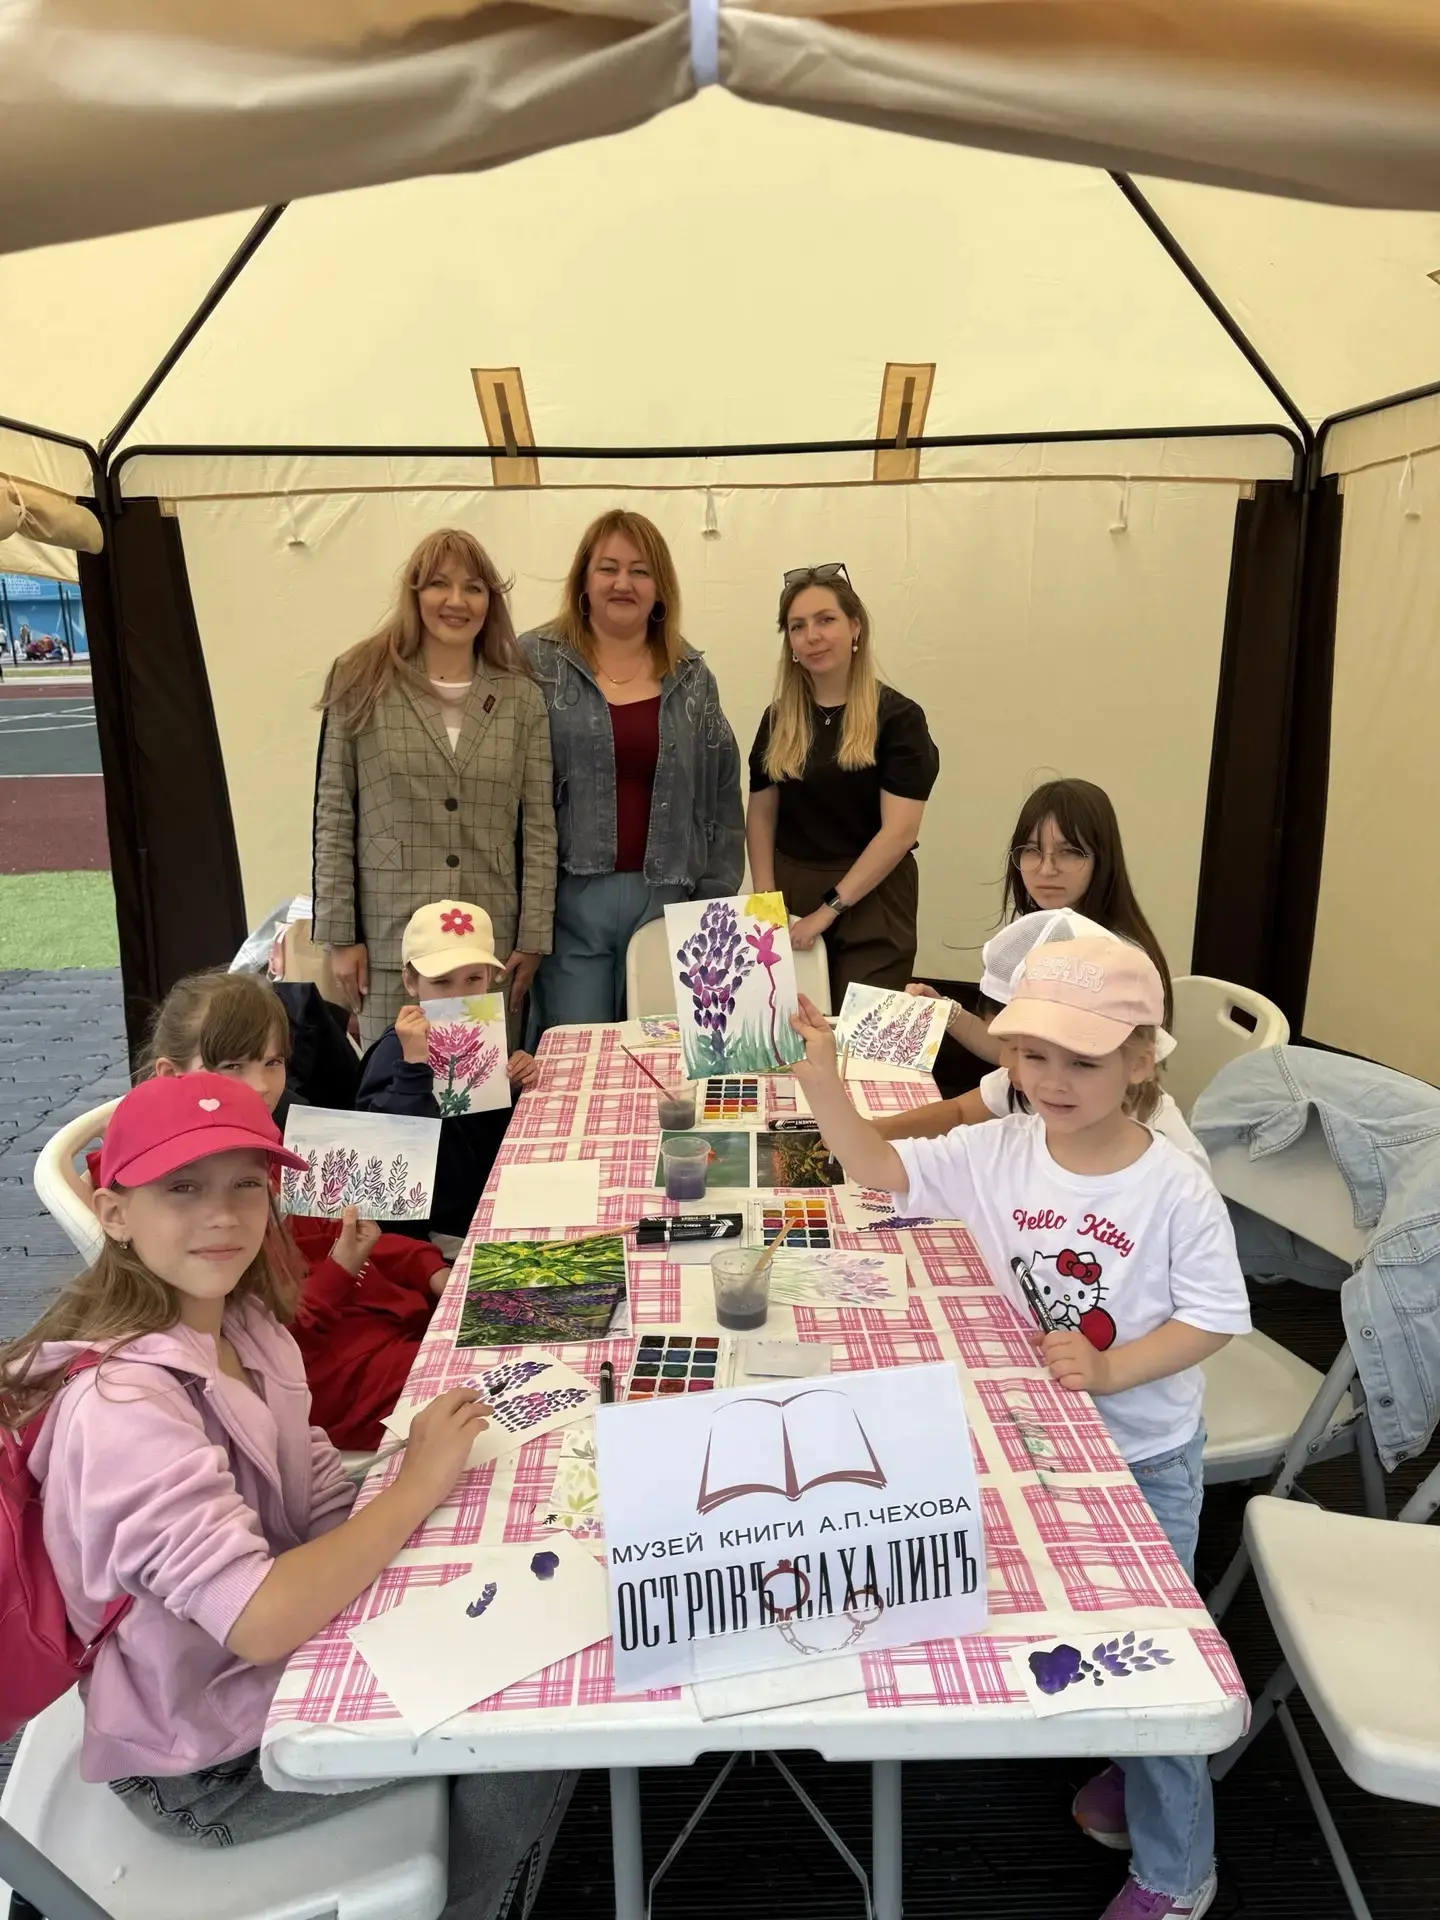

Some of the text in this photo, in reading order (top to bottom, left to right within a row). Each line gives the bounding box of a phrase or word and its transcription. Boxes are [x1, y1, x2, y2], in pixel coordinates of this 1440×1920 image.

[1012, 1209, 1135, 1258] Hello Kitty
[611, 1496, 972, 1565] МУЗЕЙ КНИГИ А.П.ЧЕХОВА
[616, 1529, 978, 1652] ОСТРОВЪ САХАЛИНЪ
